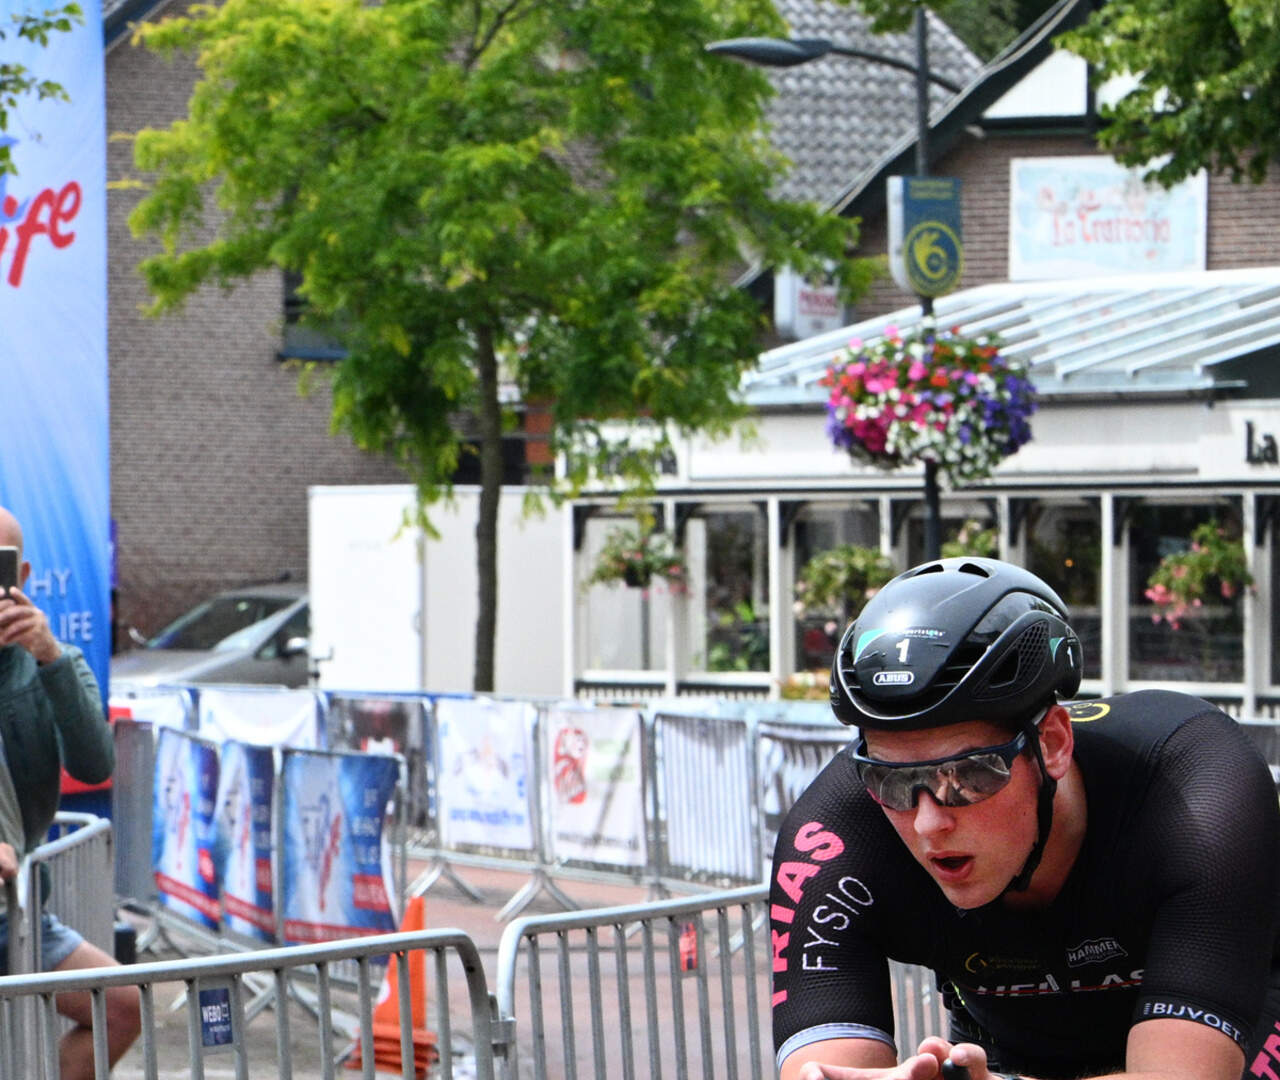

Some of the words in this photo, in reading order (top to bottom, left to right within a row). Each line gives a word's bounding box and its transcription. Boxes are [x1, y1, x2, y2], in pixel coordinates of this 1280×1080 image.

[1245, 418, 1280, 466] La
[895, 638, 911, 665] 1
[878, 673, 910, 684] ABUS
[802, 876, 874, 972] FYSIO
[1152, 1002, 1242, 1043] BIJVOET
